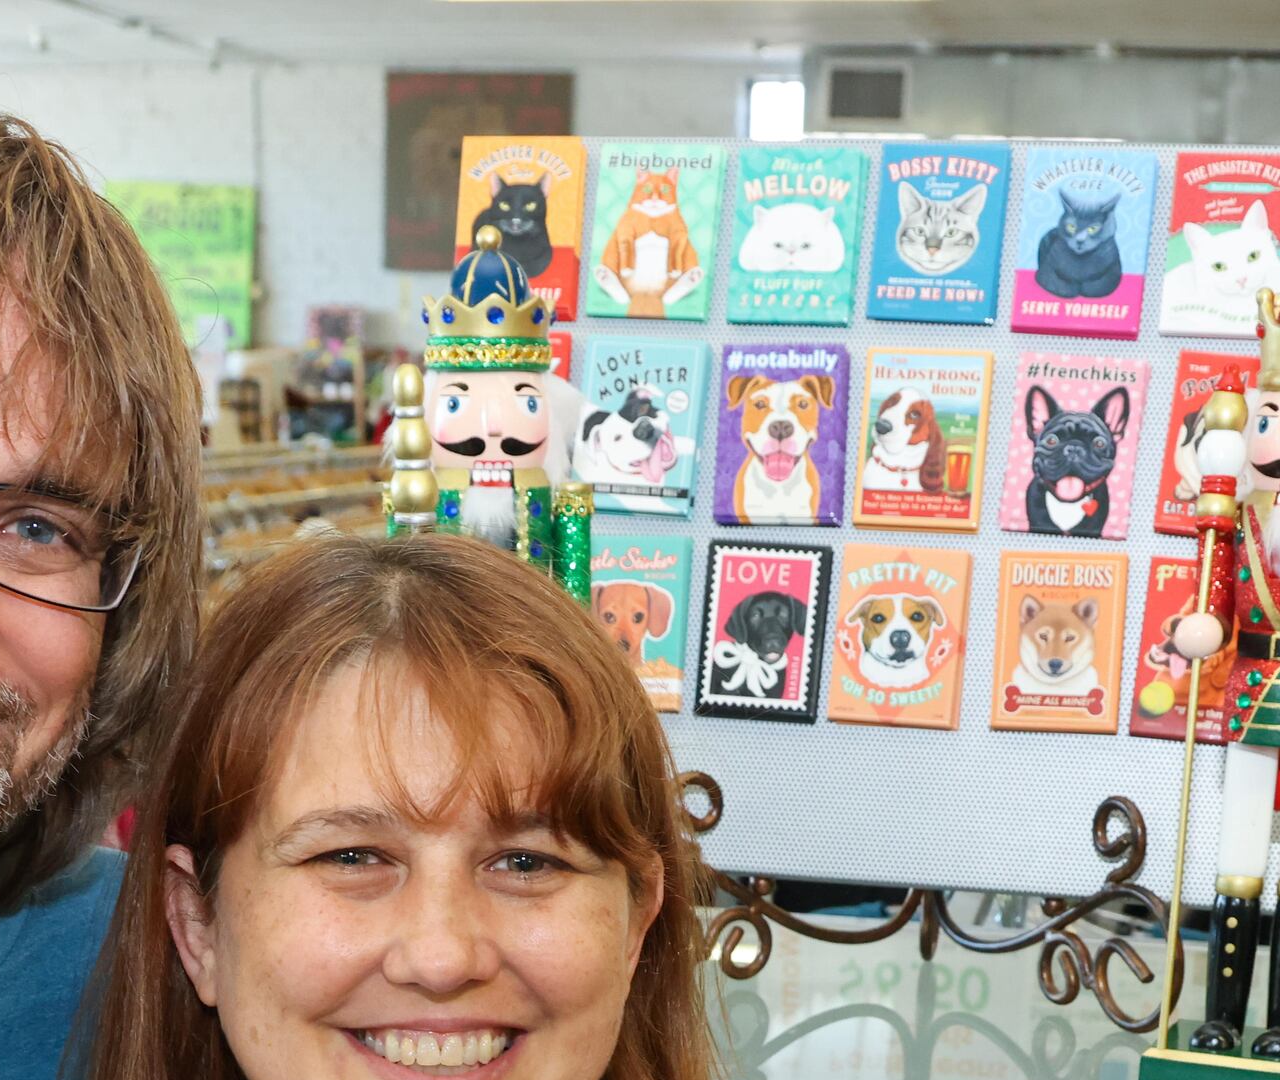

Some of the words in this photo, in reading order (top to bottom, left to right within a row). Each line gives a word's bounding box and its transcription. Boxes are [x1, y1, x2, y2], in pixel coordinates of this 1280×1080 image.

[608, 153, 712, 169] #bigboned
[887, 156, 942, 182] BOSSY
[946, 157, 1000, 184] KITTY
[1184, 165, 1208, 186] THE
[1207, 160, 1263, 179] INSISTENT
[744, 174, 851, 202] MELLOW
[1032, 157, 1104, 192] WHATEVER
[1109, 160, 1144, 194] KITTY
[1070, 179, 1103, 192] CAFE
[877, 284, 916, 299] FEED
[920, 286, 942, 301] ME
[945, 287, 985, 302] NOW!
[1022, 301, 1059, 315] SERVE
[1065, 303, 1129, 319] YOURSELF
[596, 350, 643, 377] LOVE
[726, 350, 838, 370] #notabully
[599, 367, 688, 399] MONSTER
[1027, 365, 1137, 383] #frenchkiss
[726, 560, 791, 587] LOVE
[847, 562, 921, 590] PRETTY
[926, 567, 957, 594] PIT
[1012, 563, 1069, 587] DOGGIE
[1074, 565, 1113, 588] BOSS
